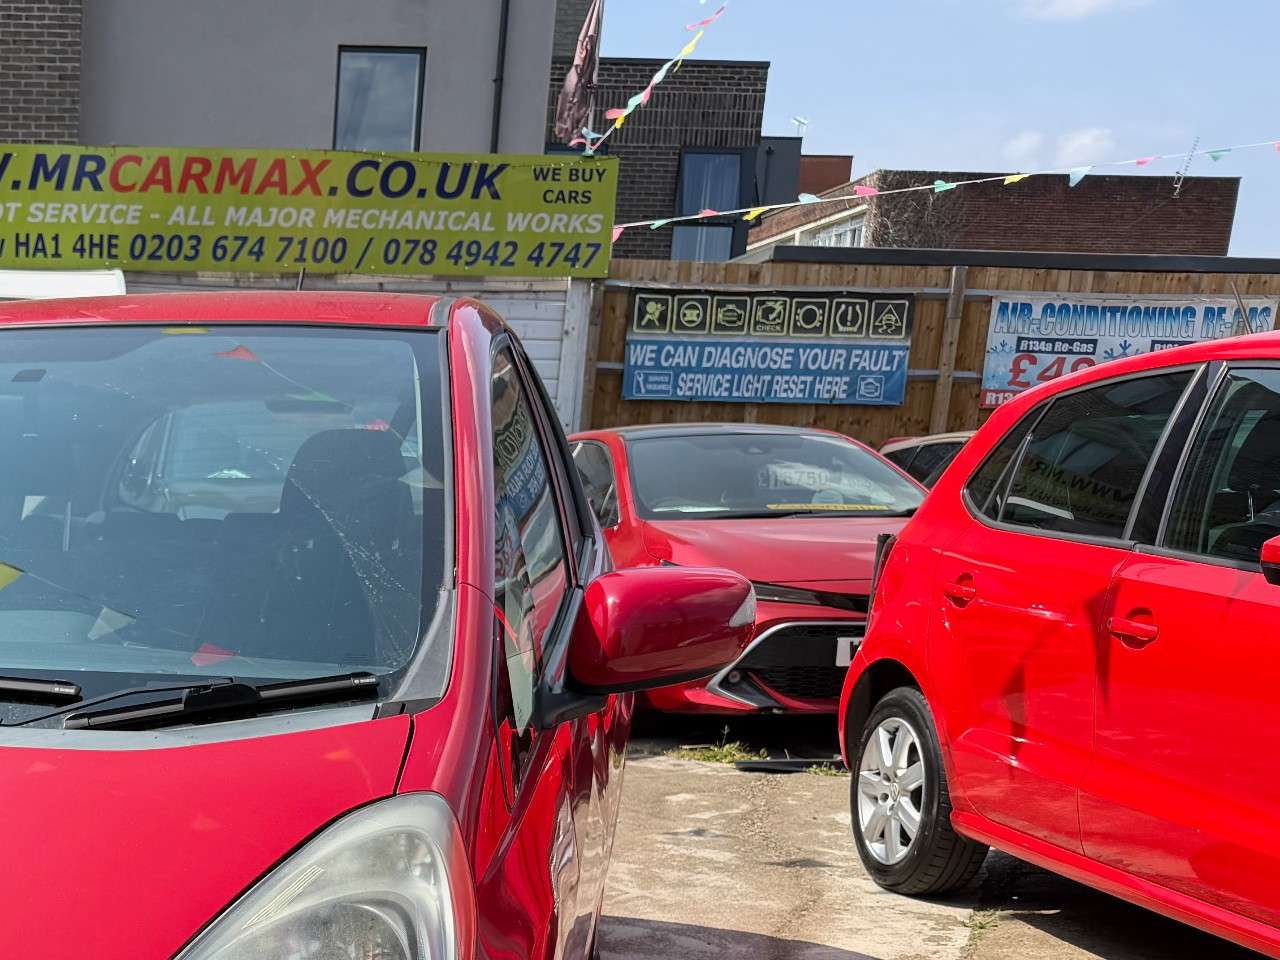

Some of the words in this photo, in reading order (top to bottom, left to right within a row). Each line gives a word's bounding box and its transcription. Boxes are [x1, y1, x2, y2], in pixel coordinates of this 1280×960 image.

[532, 166, 563, 182] WE
[569, 167, 607, 183] BUY
[542, 188, 592, 204] CARS
[26, 203, 142, 225] SERVICE
[168, 205, 216, 227] ALL
[223, 207, 315, 229] MAJOR
[322, 209, 496, 232] MECHANICAL
[506, 213, 604, 234] WORKS
[16, 233, 61, 259] HA1
[72, 234, 119, 260] 4HE
[129, 234, 202, 262] 0203
[211, 235, 264, 263] 674
[276, 236, 347, 264] 7100
[383, 238, 438, 266] 078
[446, 240, 518, 267] 4942
[527, 242, 602, 269] 4747
[993, 301, 1197, 338] AIR-CONDITIONING
[1200, 305, 1272, 338] RE-GAS
[629, 344, 656, 366] WE
[660, 345, 701, 368] CAN
[702, 346, 796, 369] DIAGNOSE
[798, 348, 846, 371] YOUR
[849, 349, 907, 372] FAULT
[1019, 339, 1053, 352] R134a
[1053, 340, 1095, 353] Re-Gas
[677, 372, 731, 397] SERVICE
[733, 374, 770, 398] LIGHT
[773, 375, 813, 399] RESET
[815, 376, 850, 399] HERE
